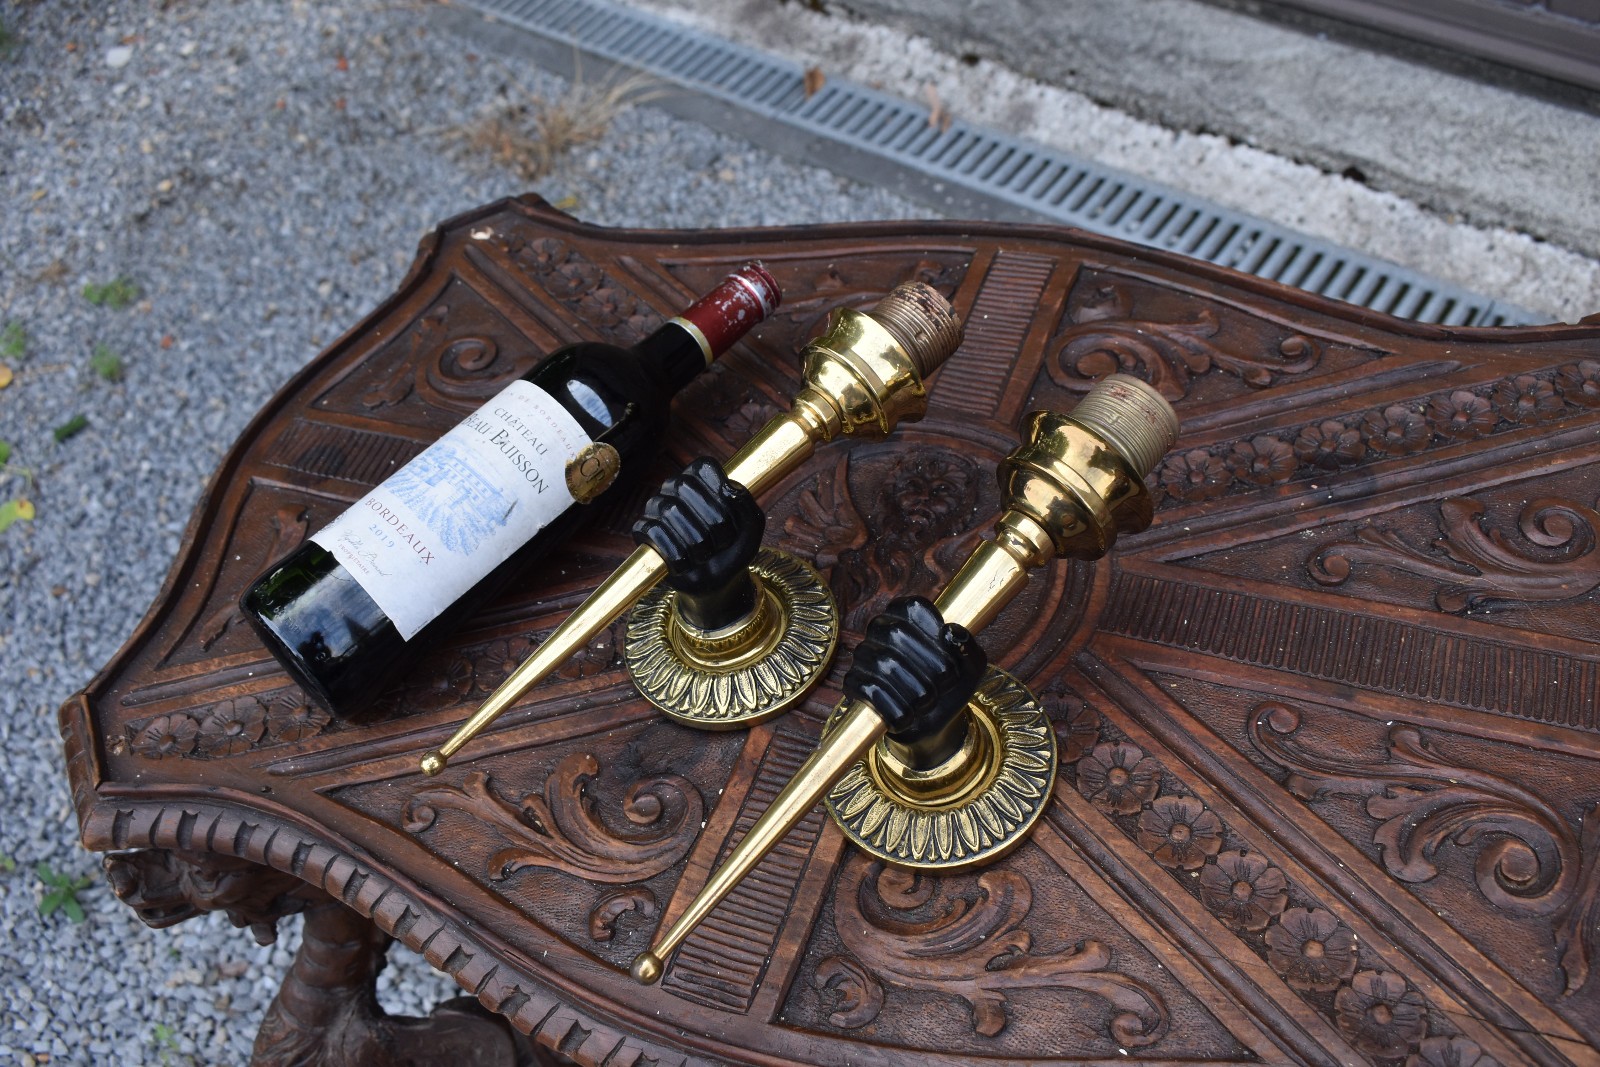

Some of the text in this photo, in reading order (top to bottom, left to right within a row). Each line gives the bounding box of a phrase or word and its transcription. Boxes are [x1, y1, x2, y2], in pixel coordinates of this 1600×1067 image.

[494, 407, 548, 456] CHÂTEAU
[533, 404, 576, 458] BORDEAUX
[489, 429, 550, 495] BUISSON
[365, 497, 436, 565] BORDEAUX
[368, 523, 395, 548] 2019
